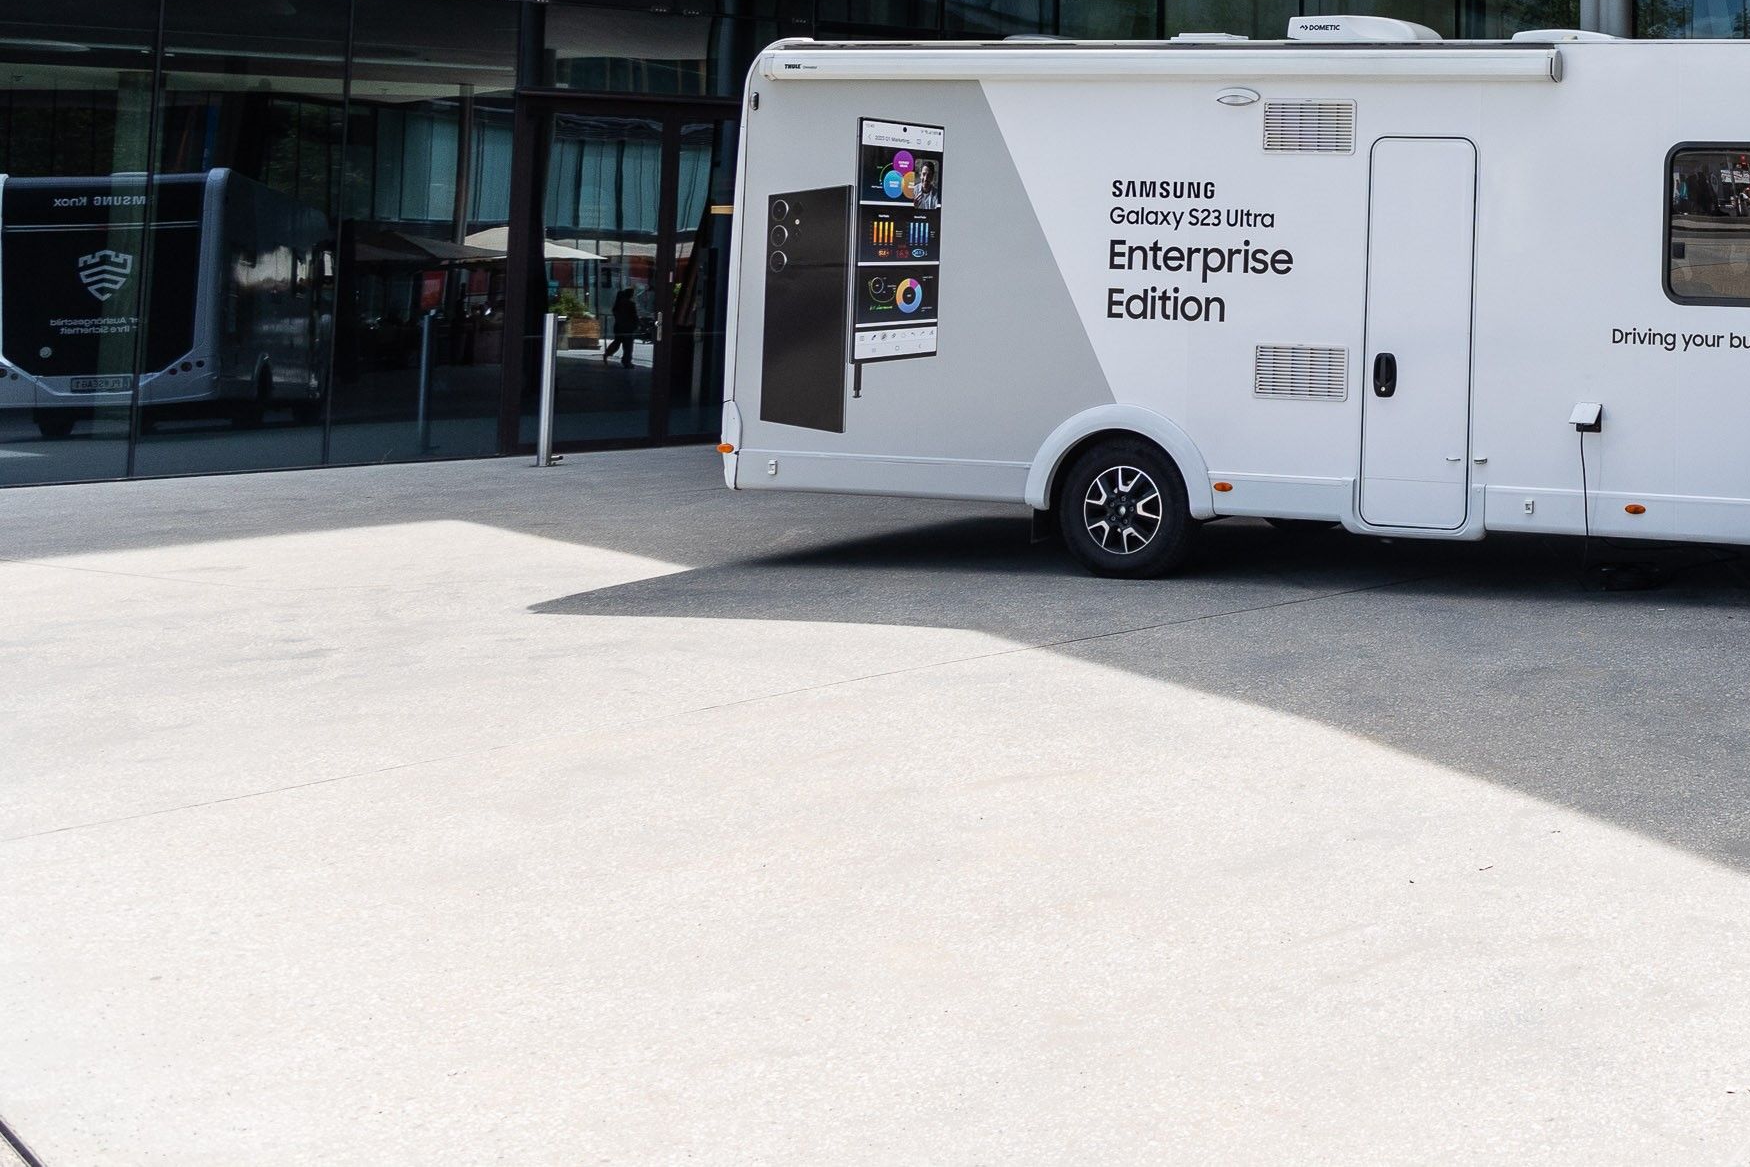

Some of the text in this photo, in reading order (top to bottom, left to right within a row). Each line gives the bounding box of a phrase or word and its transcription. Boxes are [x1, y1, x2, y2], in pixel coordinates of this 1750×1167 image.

[1112, 180, 1215, 199] SAMSUNG
[1110, 207, 1275, 231] Galaxy S23 Ultra
[1109, 239, 1294, 283] Enterprise
[1107, 286, 1226, 322] Edition
[1612, 328, 1676, 351] Driving
[1682, 333, 1724, 352] your
